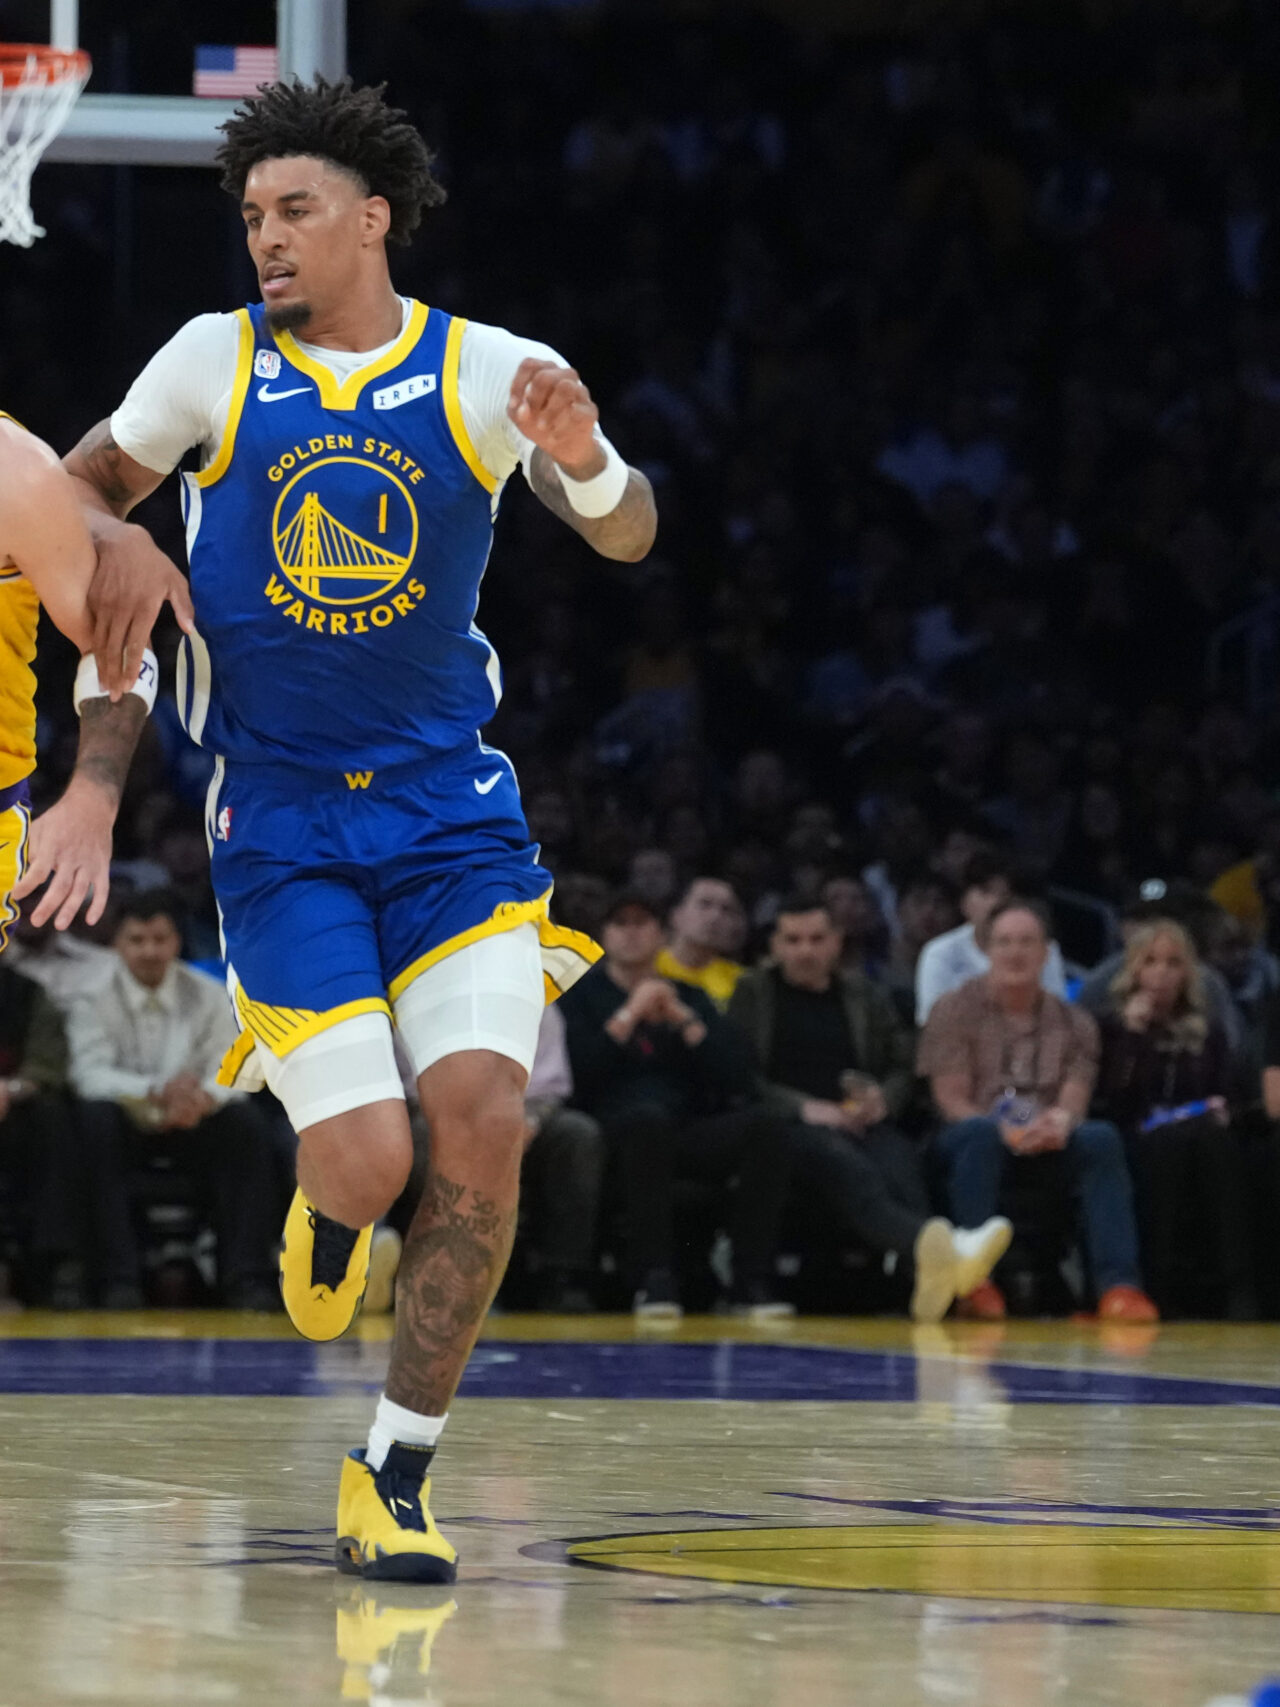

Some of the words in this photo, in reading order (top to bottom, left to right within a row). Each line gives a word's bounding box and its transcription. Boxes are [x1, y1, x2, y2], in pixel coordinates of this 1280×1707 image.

[378, 377, 430, 406] IREN
[267, 434, 353, 482] GOLDEN
[363, 438, 425, 485] STATE
[378, 493, 388, 534] 1
[263, 573, 427, 635] WARRIORS
